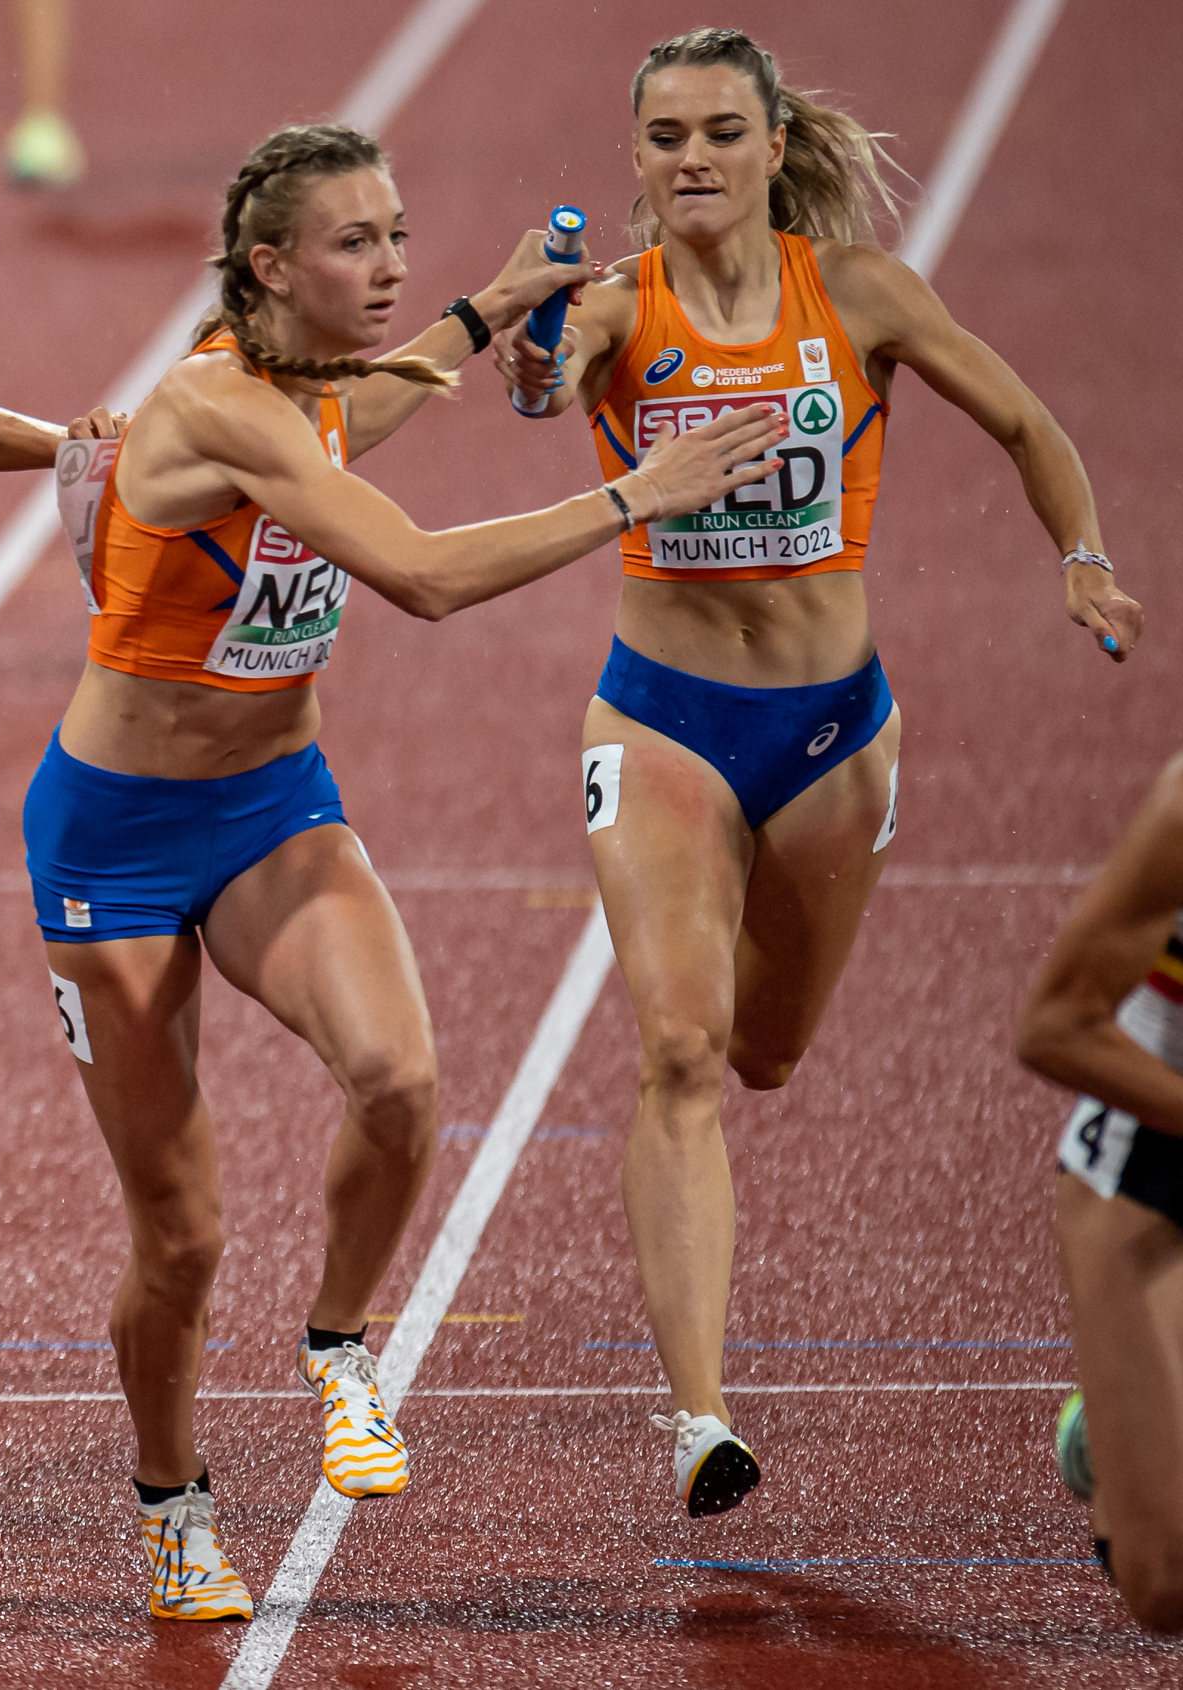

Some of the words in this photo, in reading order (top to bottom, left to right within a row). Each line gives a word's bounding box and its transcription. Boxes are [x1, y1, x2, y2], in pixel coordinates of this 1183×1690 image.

[716, 363, 785, 377] NEDERLANDSE
[716, 375, 762, 386] LOTERIJ
[698, 446, 825, 513] ED
[692, 515, 697, 530] I
[703, 514, 740, 530] RUN
[661, 535, 768, 561] MUNICH
[778, 526, 833, 558] 2022
[263, 632, 270, 643] I
[272, 627, 299, 644] RUN
[222, 646, 311, 671] MUNICH
[586, 760, 602, 823] 6
[1080, 1107, 1108, 1169] 4
